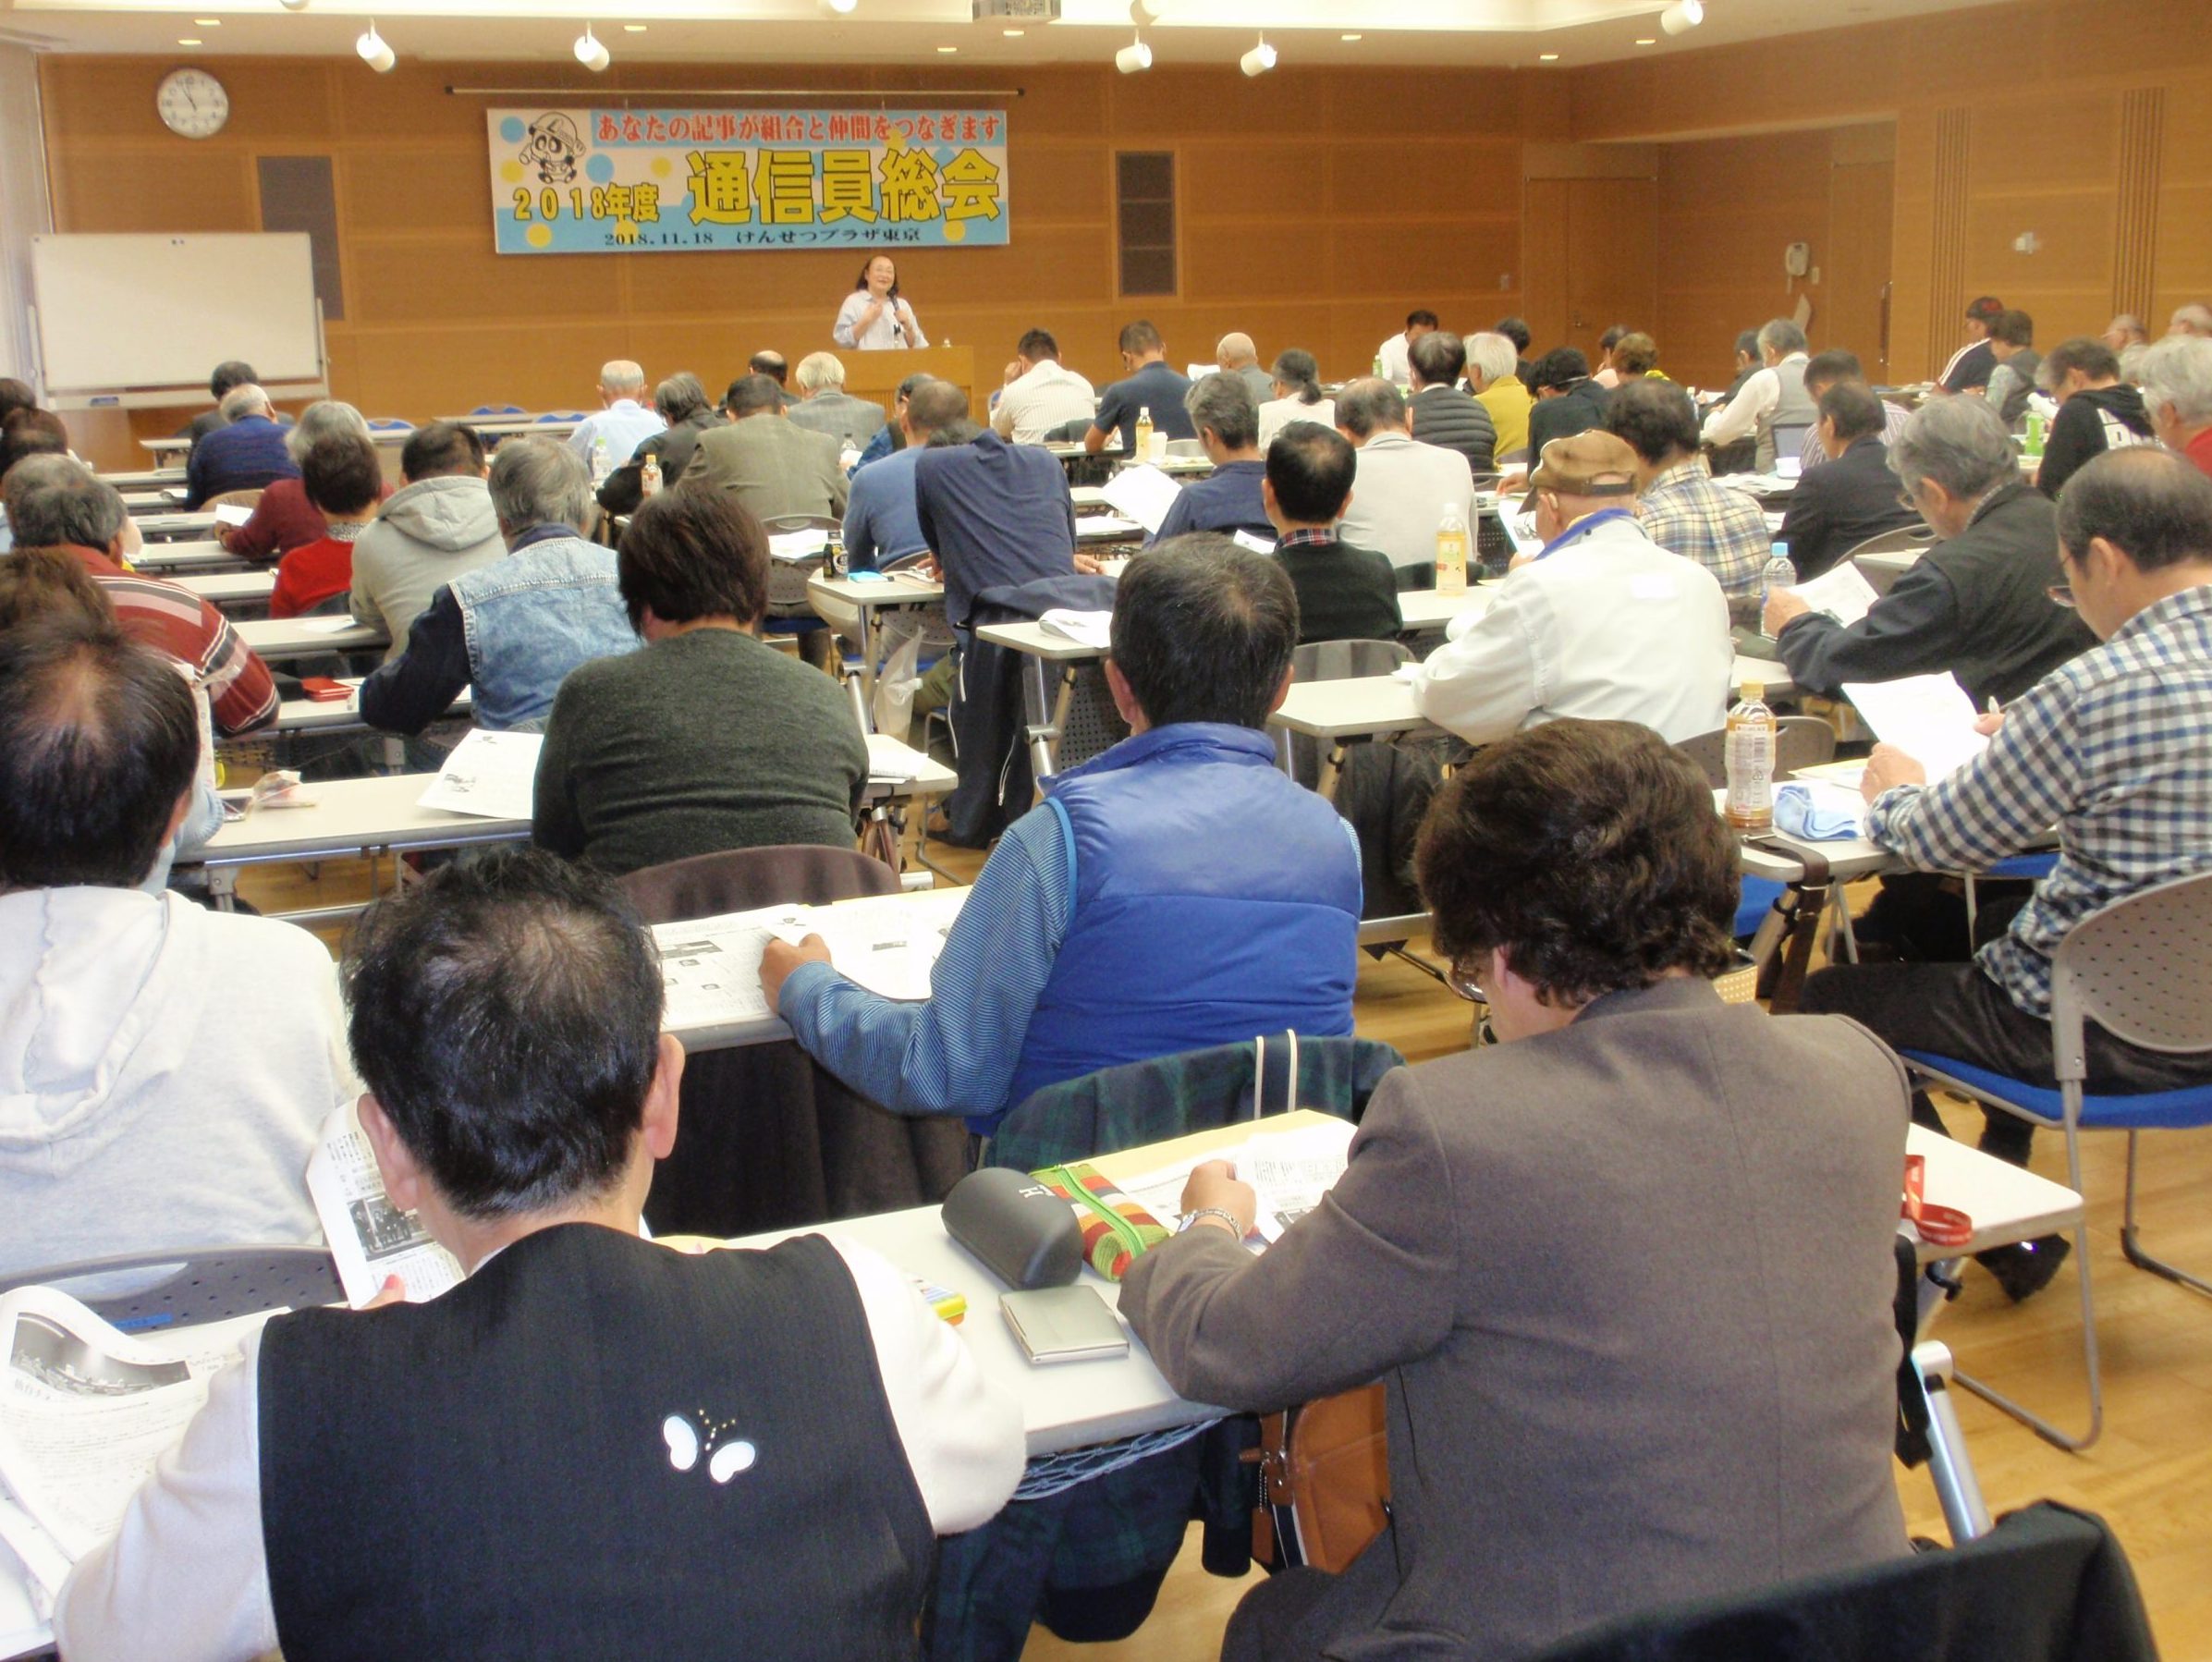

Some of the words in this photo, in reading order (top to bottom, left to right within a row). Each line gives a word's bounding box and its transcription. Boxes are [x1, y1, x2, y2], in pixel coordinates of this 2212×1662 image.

[598, 114, 999, 141] あなたの記事が組合と仲間をつなぎます
[513, 183, 660, 222] 2018年度
[685, 148, 1000, 226] 通信員総会
[605, 233, 714, 246] 2018.11.18
[736, 228, 921, 244] けんせつプラザ東京
